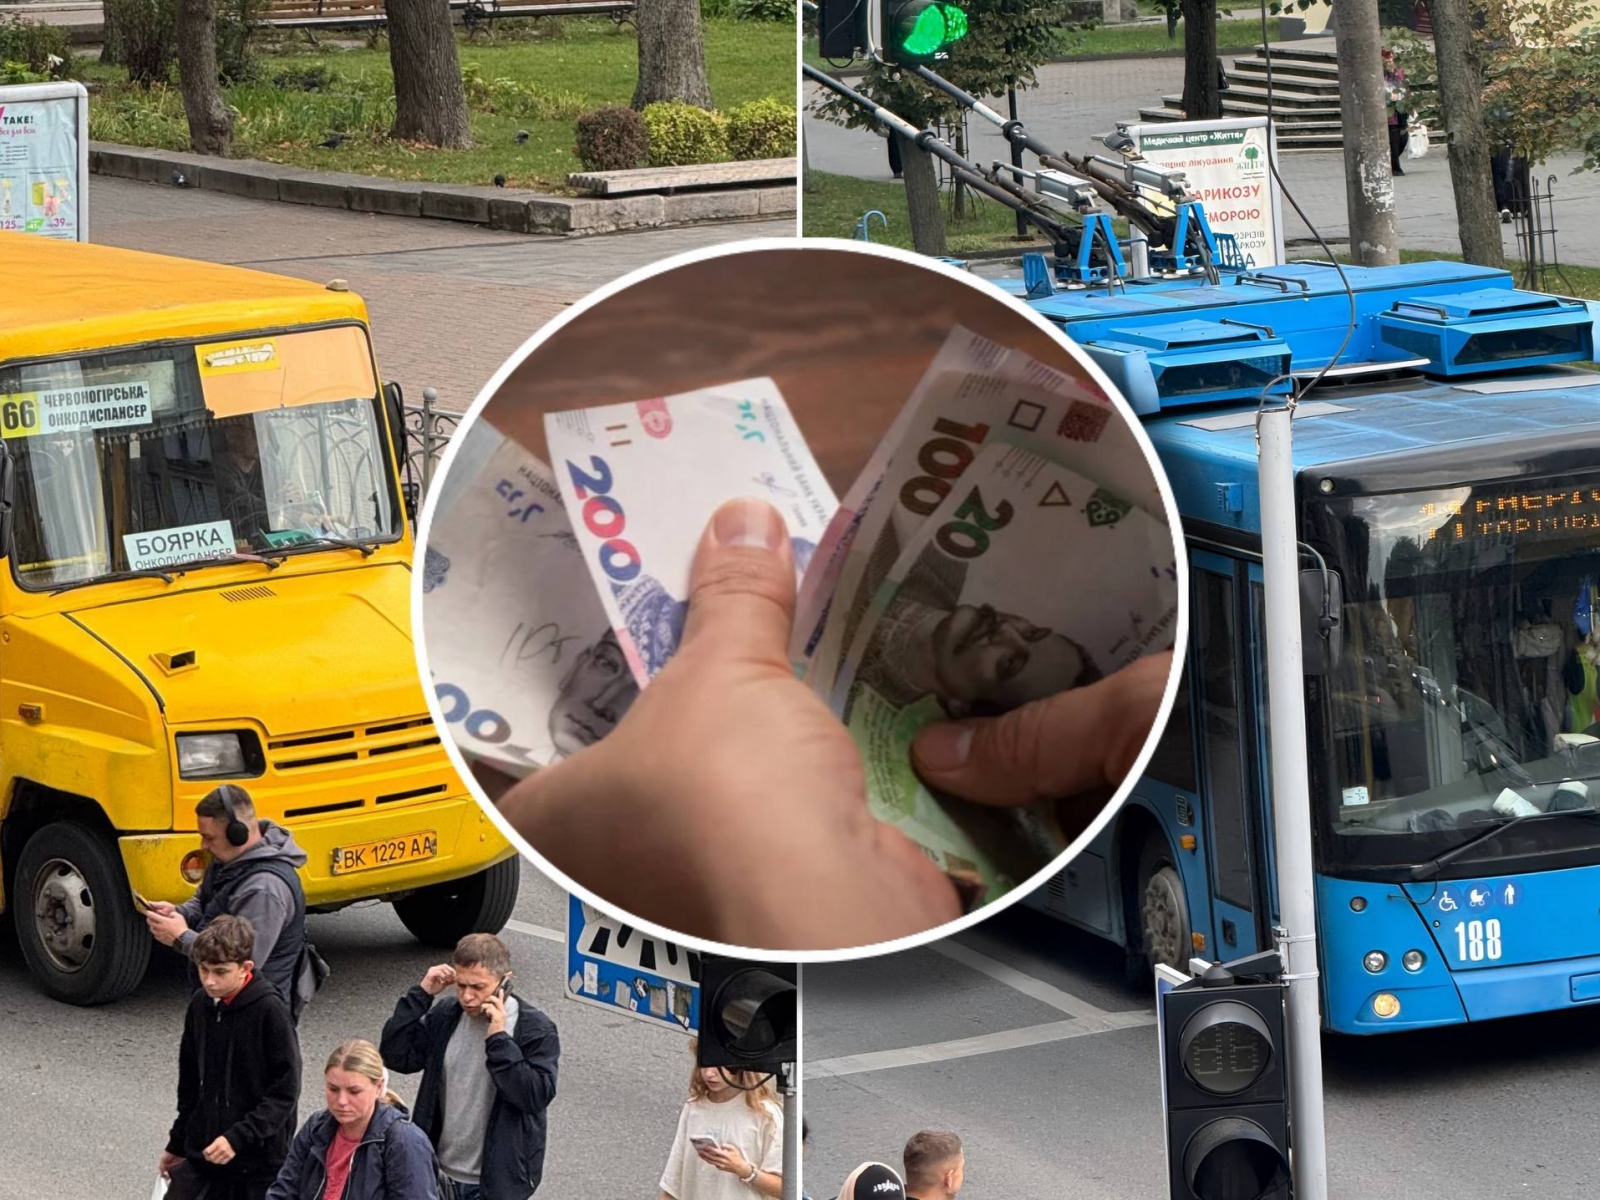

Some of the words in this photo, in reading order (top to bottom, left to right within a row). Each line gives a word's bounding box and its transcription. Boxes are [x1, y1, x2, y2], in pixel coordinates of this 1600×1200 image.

[1185, 134, 1208, 143] центр
[1189, 156, 1234, 167] лікування
[1205, 208, 1260, 223] МОРОЮ
[1233, 230, 1265, 240] ОЗРІЗІВ
[2, 400, 36, 430] 66
[44, 385, 149, 408] ЧЕРВОНОГІРСЬКА-
[48, 404, 147, 427] ОНКОДИСПАНСЕР
[899, 417, 990, 516] 100
[565, 455, 641, 582] 200
[935, 484, 1014, 560] 20
[135, 528, 224, 556] БОЯРКА
[344, 848, 366, 869] BK
[371, 840, 406, 863] 1229
[411, 836, 433, 857] AA
[1454, 918, 1502, 962] 188
